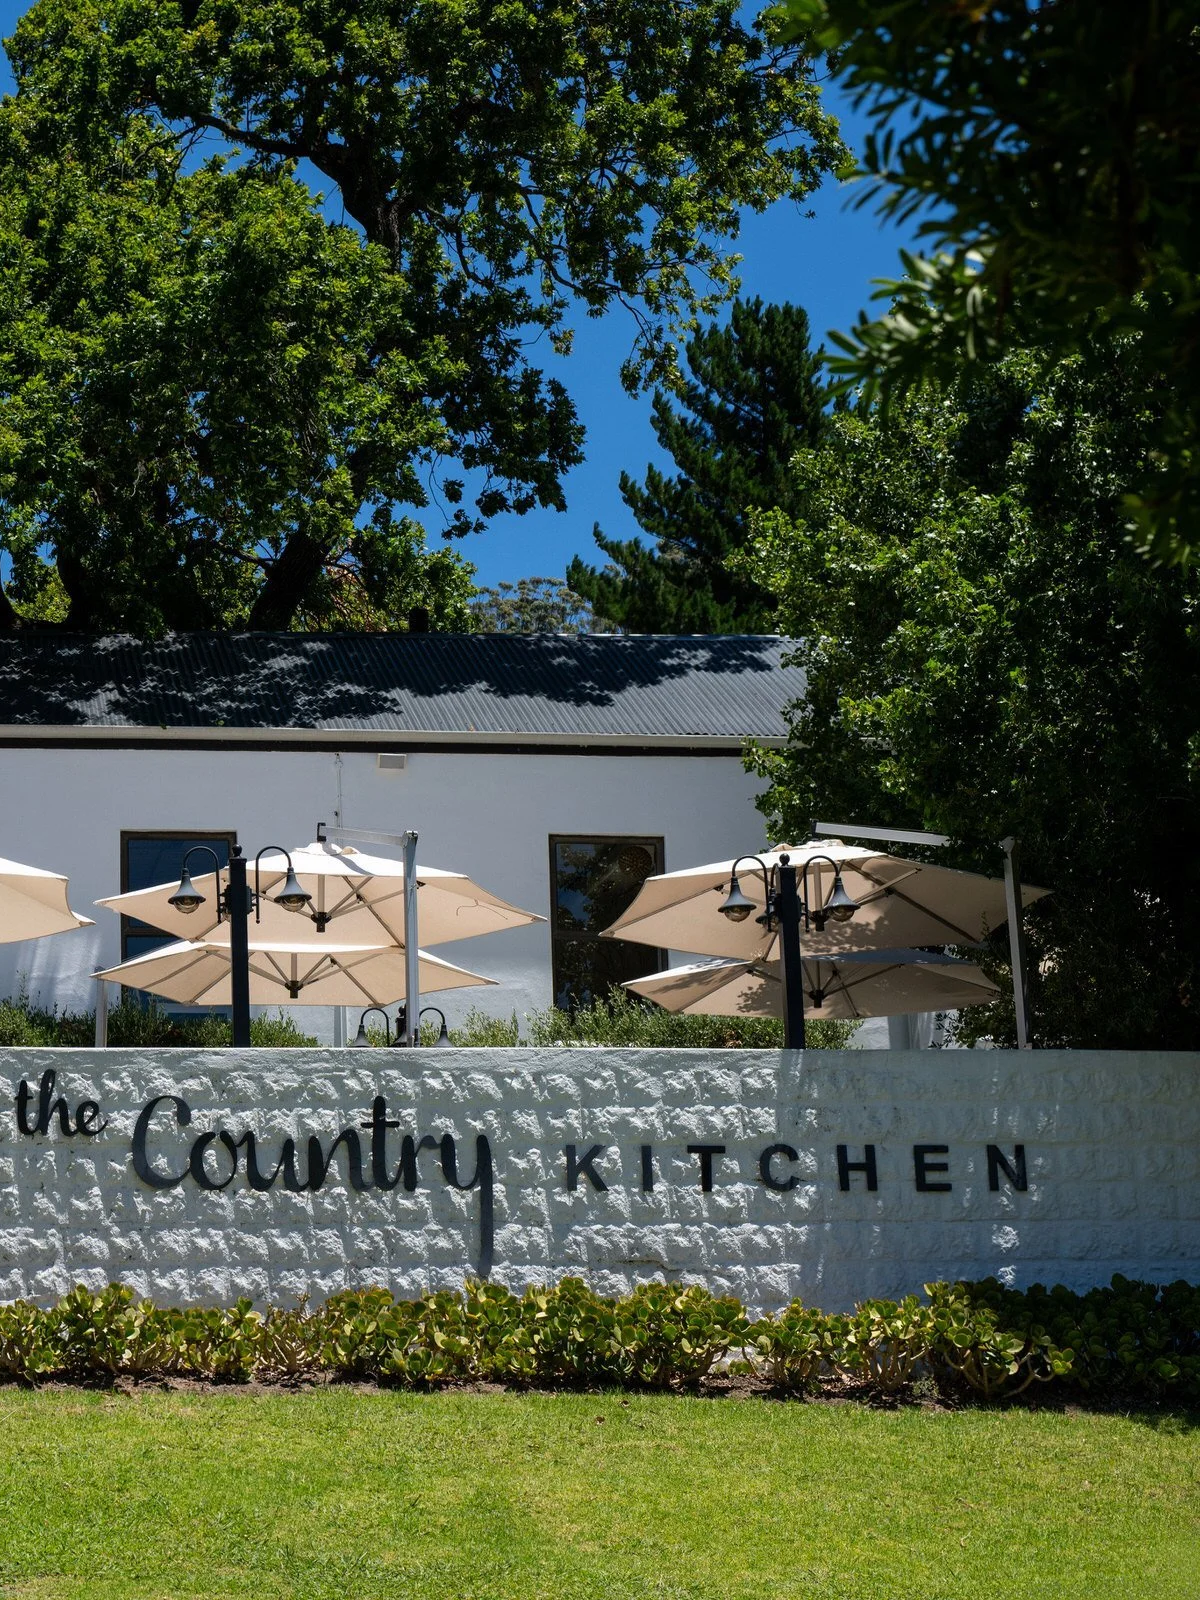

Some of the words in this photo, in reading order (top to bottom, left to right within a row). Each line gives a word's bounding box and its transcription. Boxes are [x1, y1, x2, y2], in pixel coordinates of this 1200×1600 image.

[15, 1068, 108, 1137] the
[132, 1095, 494, 1277] Country
[565, 1144, 1029, 1192] KITCHEN
